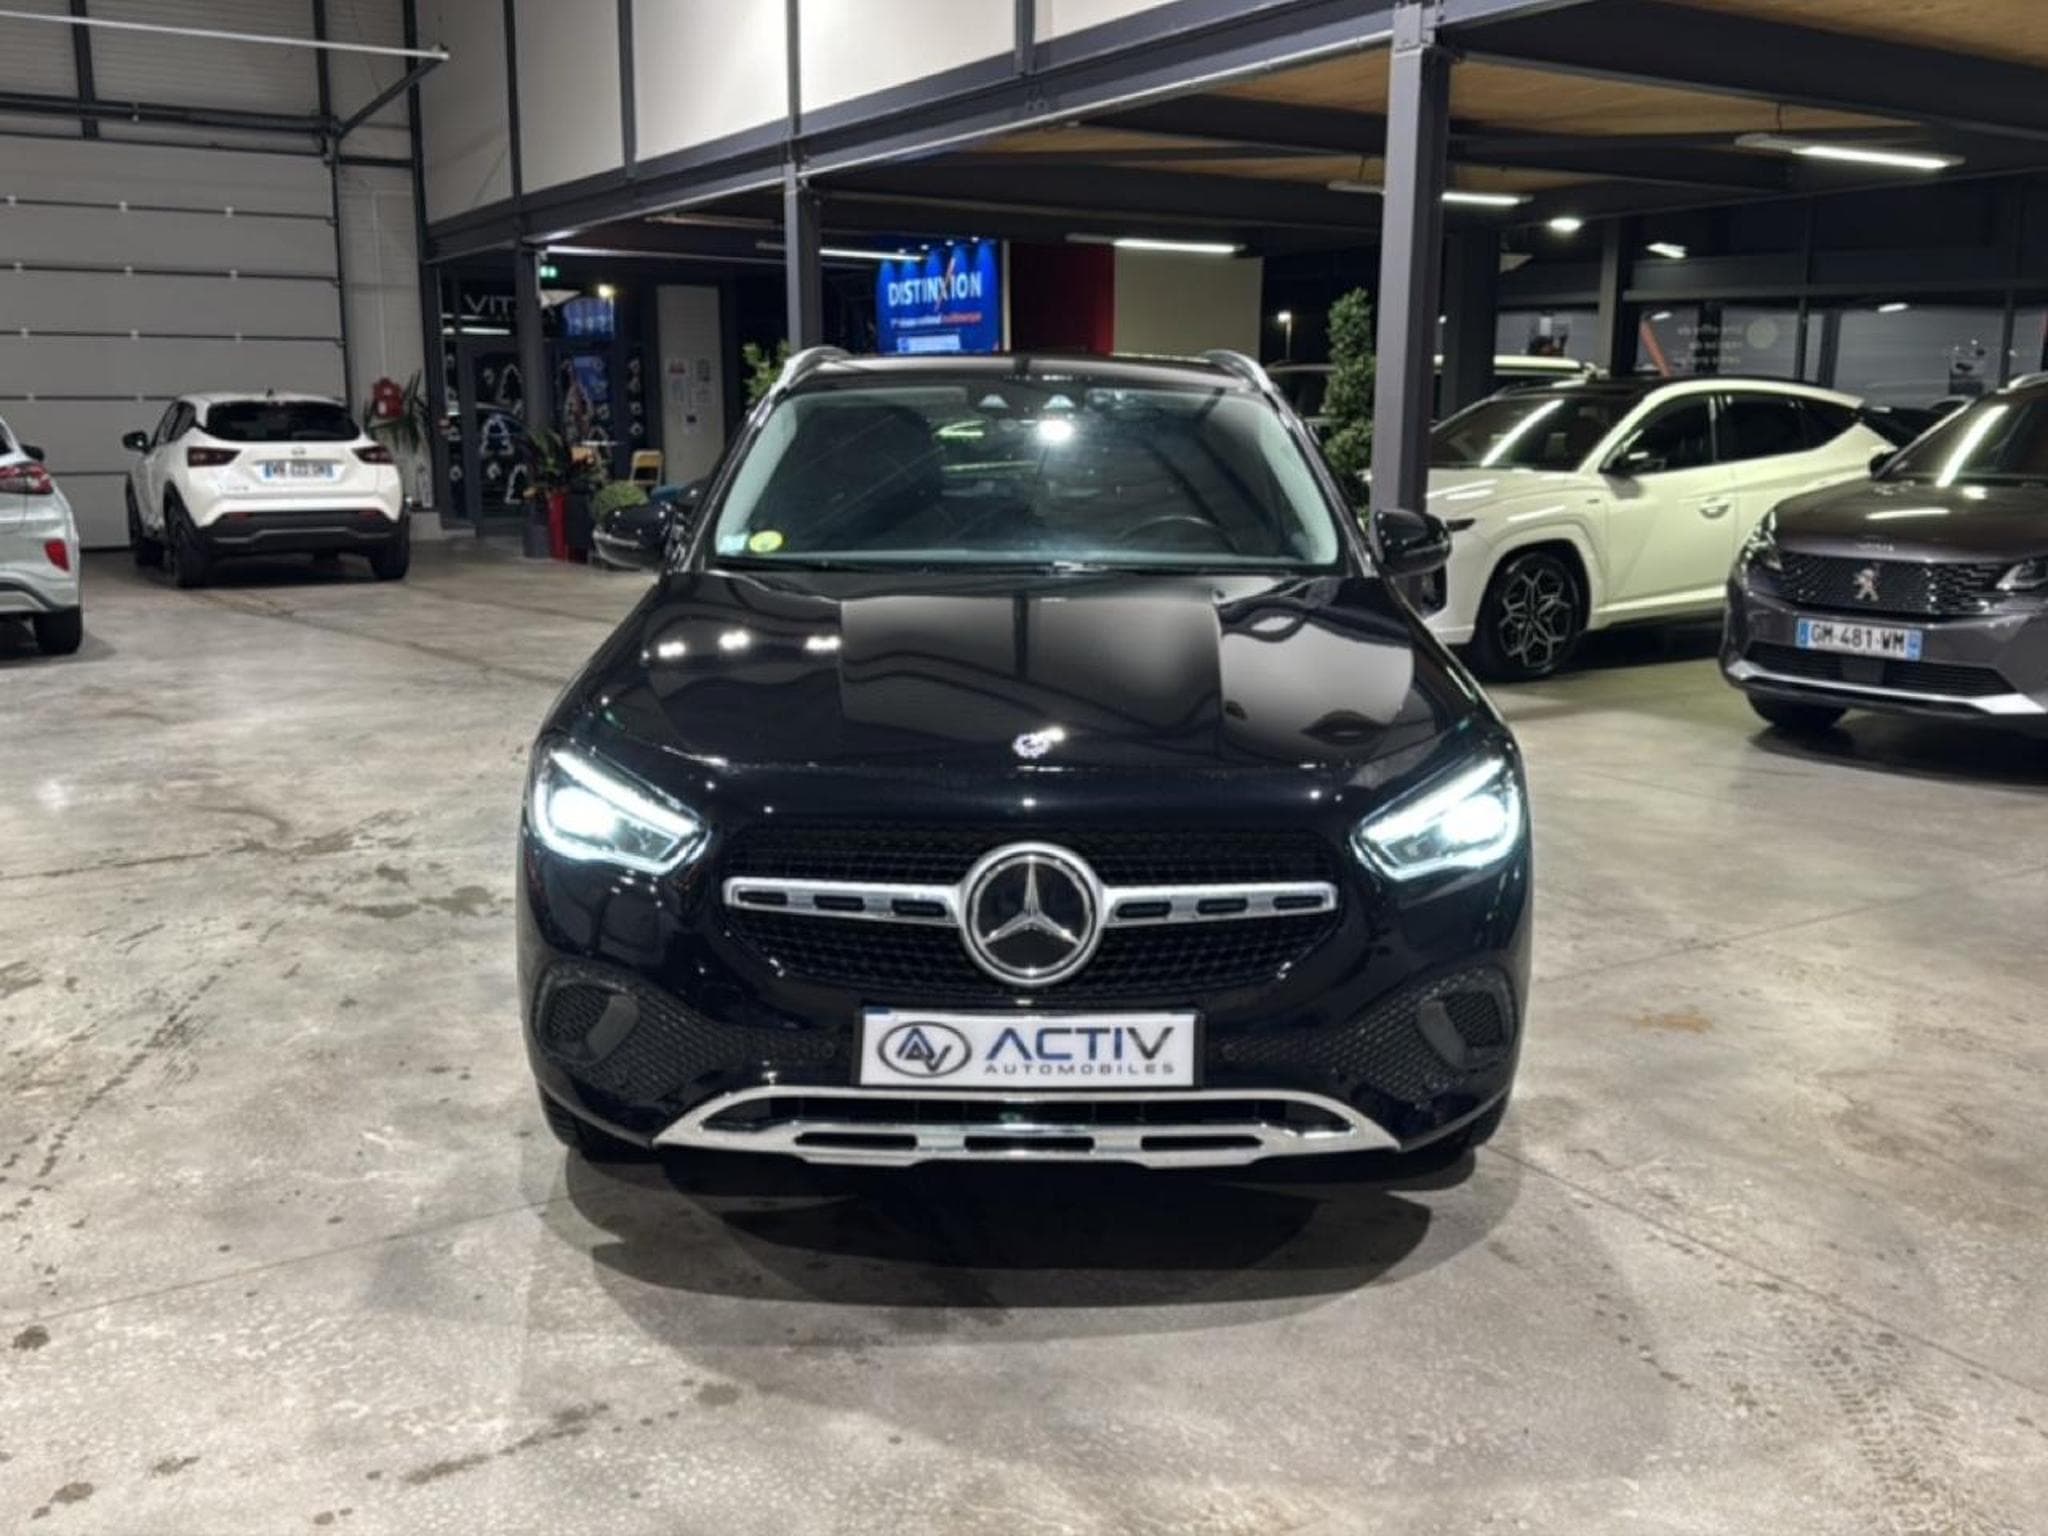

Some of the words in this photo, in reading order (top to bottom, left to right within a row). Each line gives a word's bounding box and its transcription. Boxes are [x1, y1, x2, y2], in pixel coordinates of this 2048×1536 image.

[888, 266, 983, 308] DISTINXION
[985, 1027, 1175, 1061] ACTIV
[984, 1064, 1175, 1075] AUTOMOBILES
